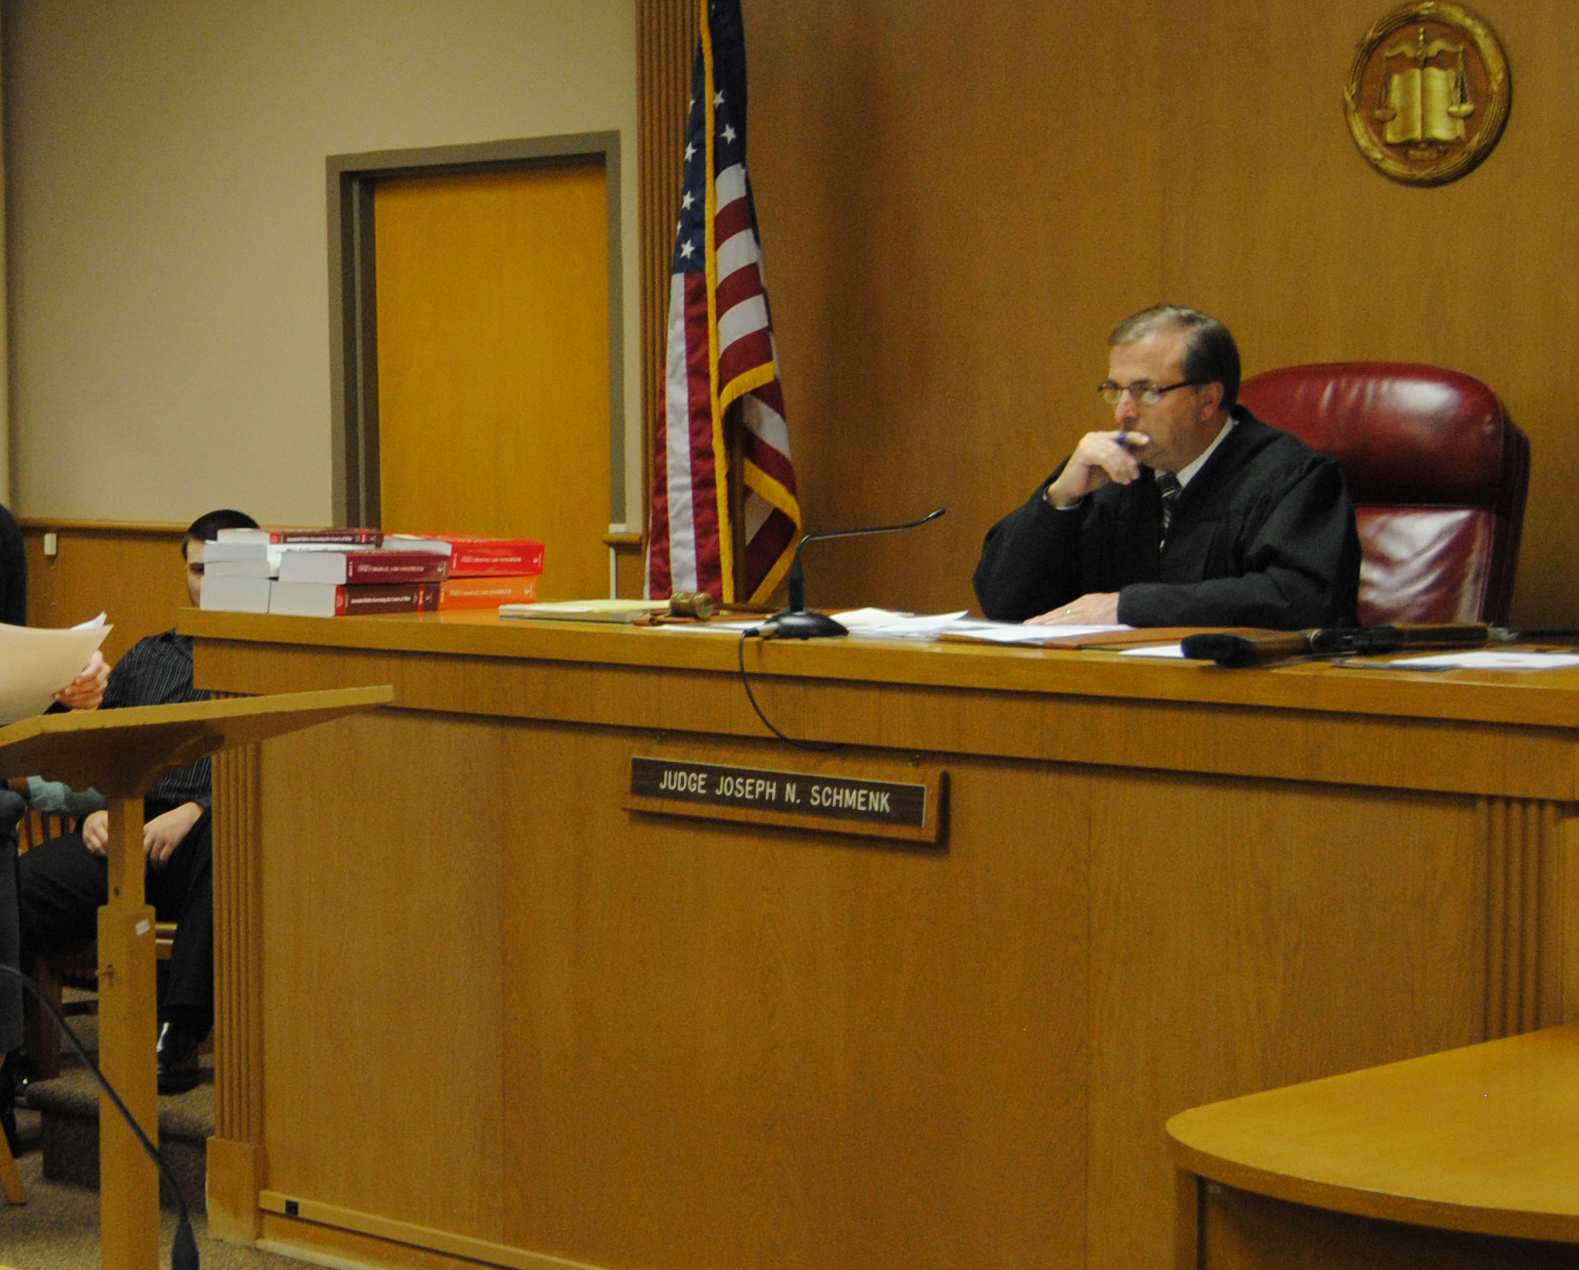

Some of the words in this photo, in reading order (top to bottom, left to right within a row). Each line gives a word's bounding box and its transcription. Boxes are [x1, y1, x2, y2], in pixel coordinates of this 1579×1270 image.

[659, 770, 708, 794] JUDGE
[715, 776, 777, 801] JOSEPH
[785, 783, 801, 804] N.
[809, 785, 891, 813] SCHMENK
